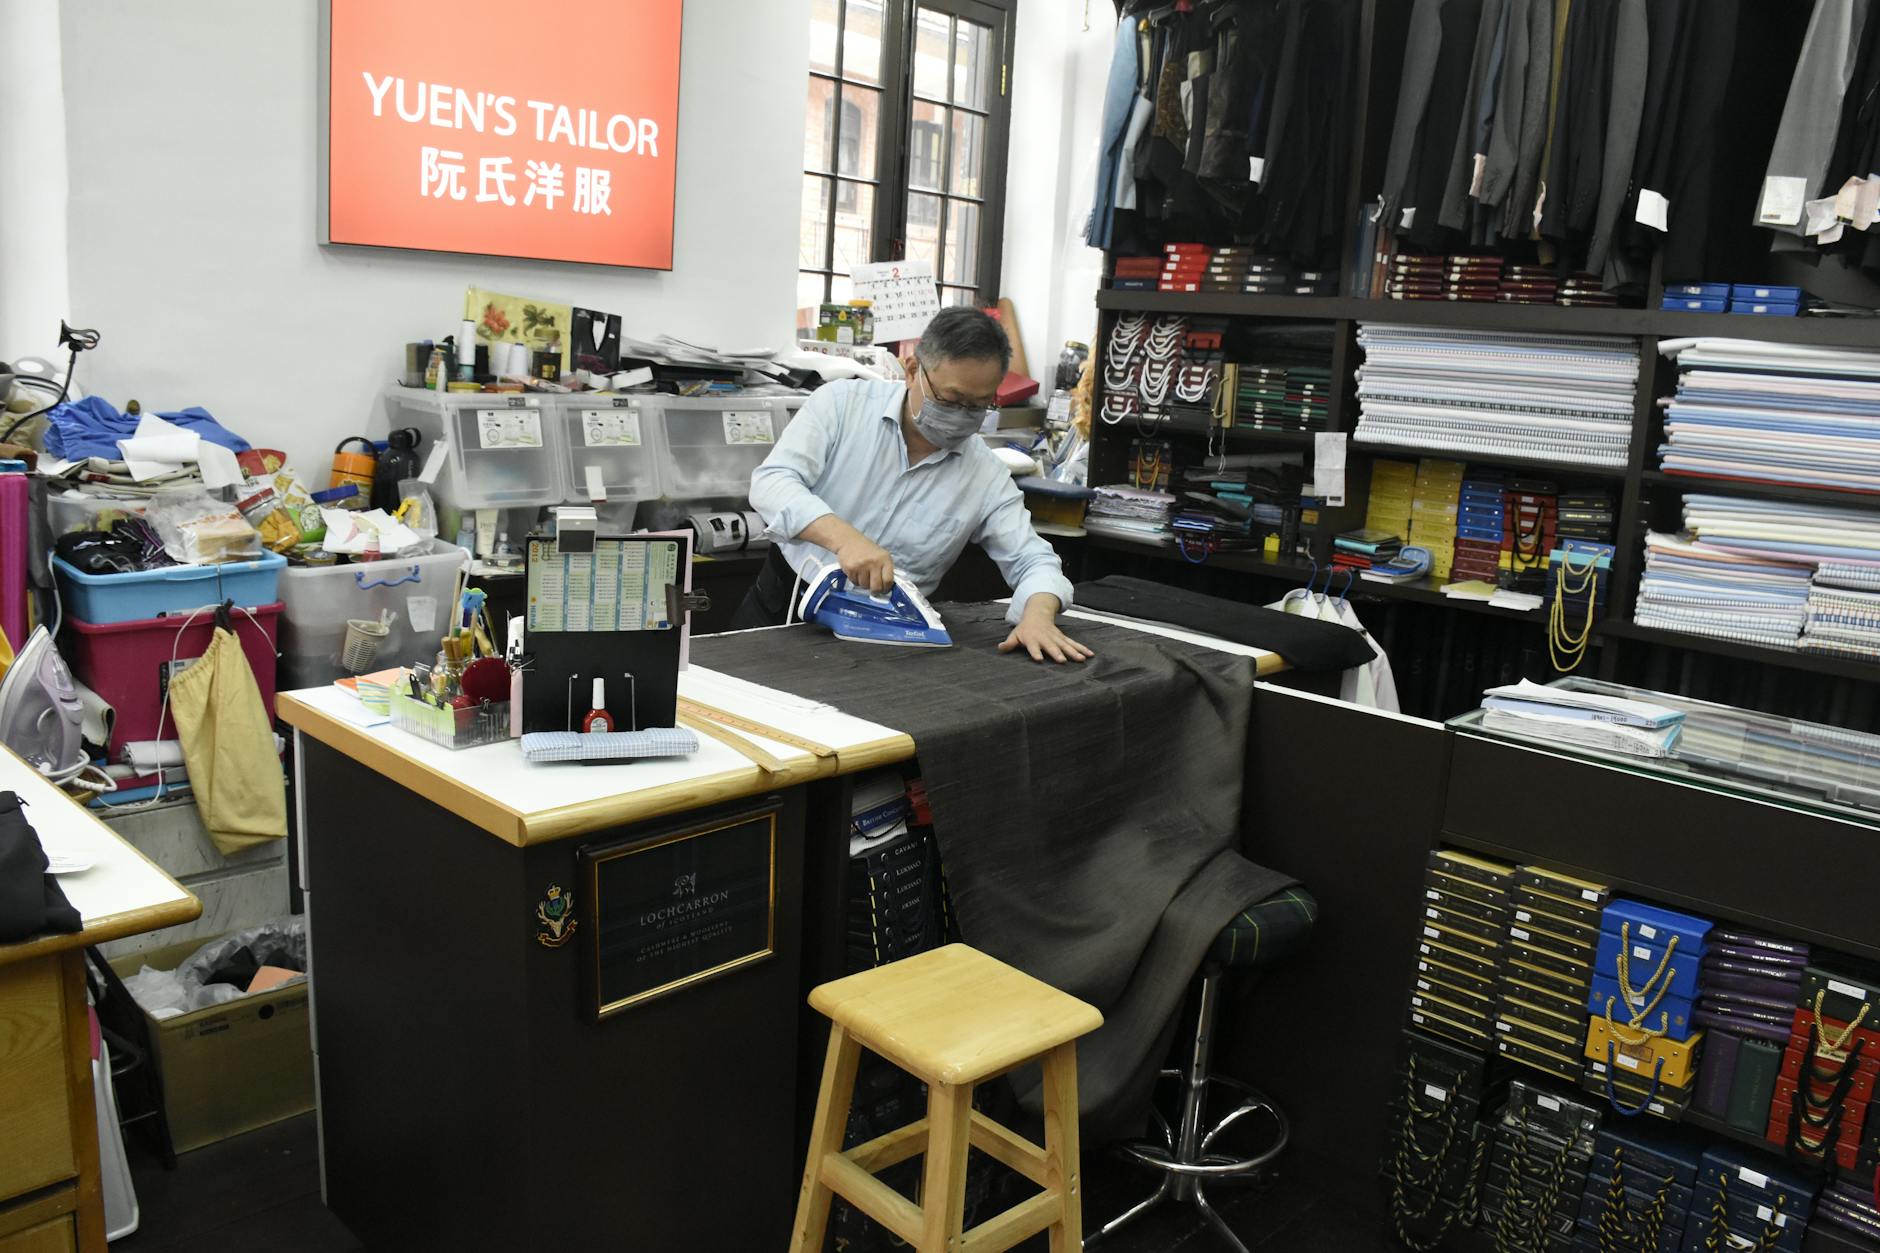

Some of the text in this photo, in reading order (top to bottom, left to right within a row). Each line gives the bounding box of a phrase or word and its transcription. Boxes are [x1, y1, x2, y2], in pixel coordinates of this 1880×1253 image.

[362, 71, 659, 158] YUEN'S TAILOR
[420, 146, 612, 216] 阮氏洋服
[892, 267, 900, 278] 2
[640, 889, 729, 927] LOCHCARRON
